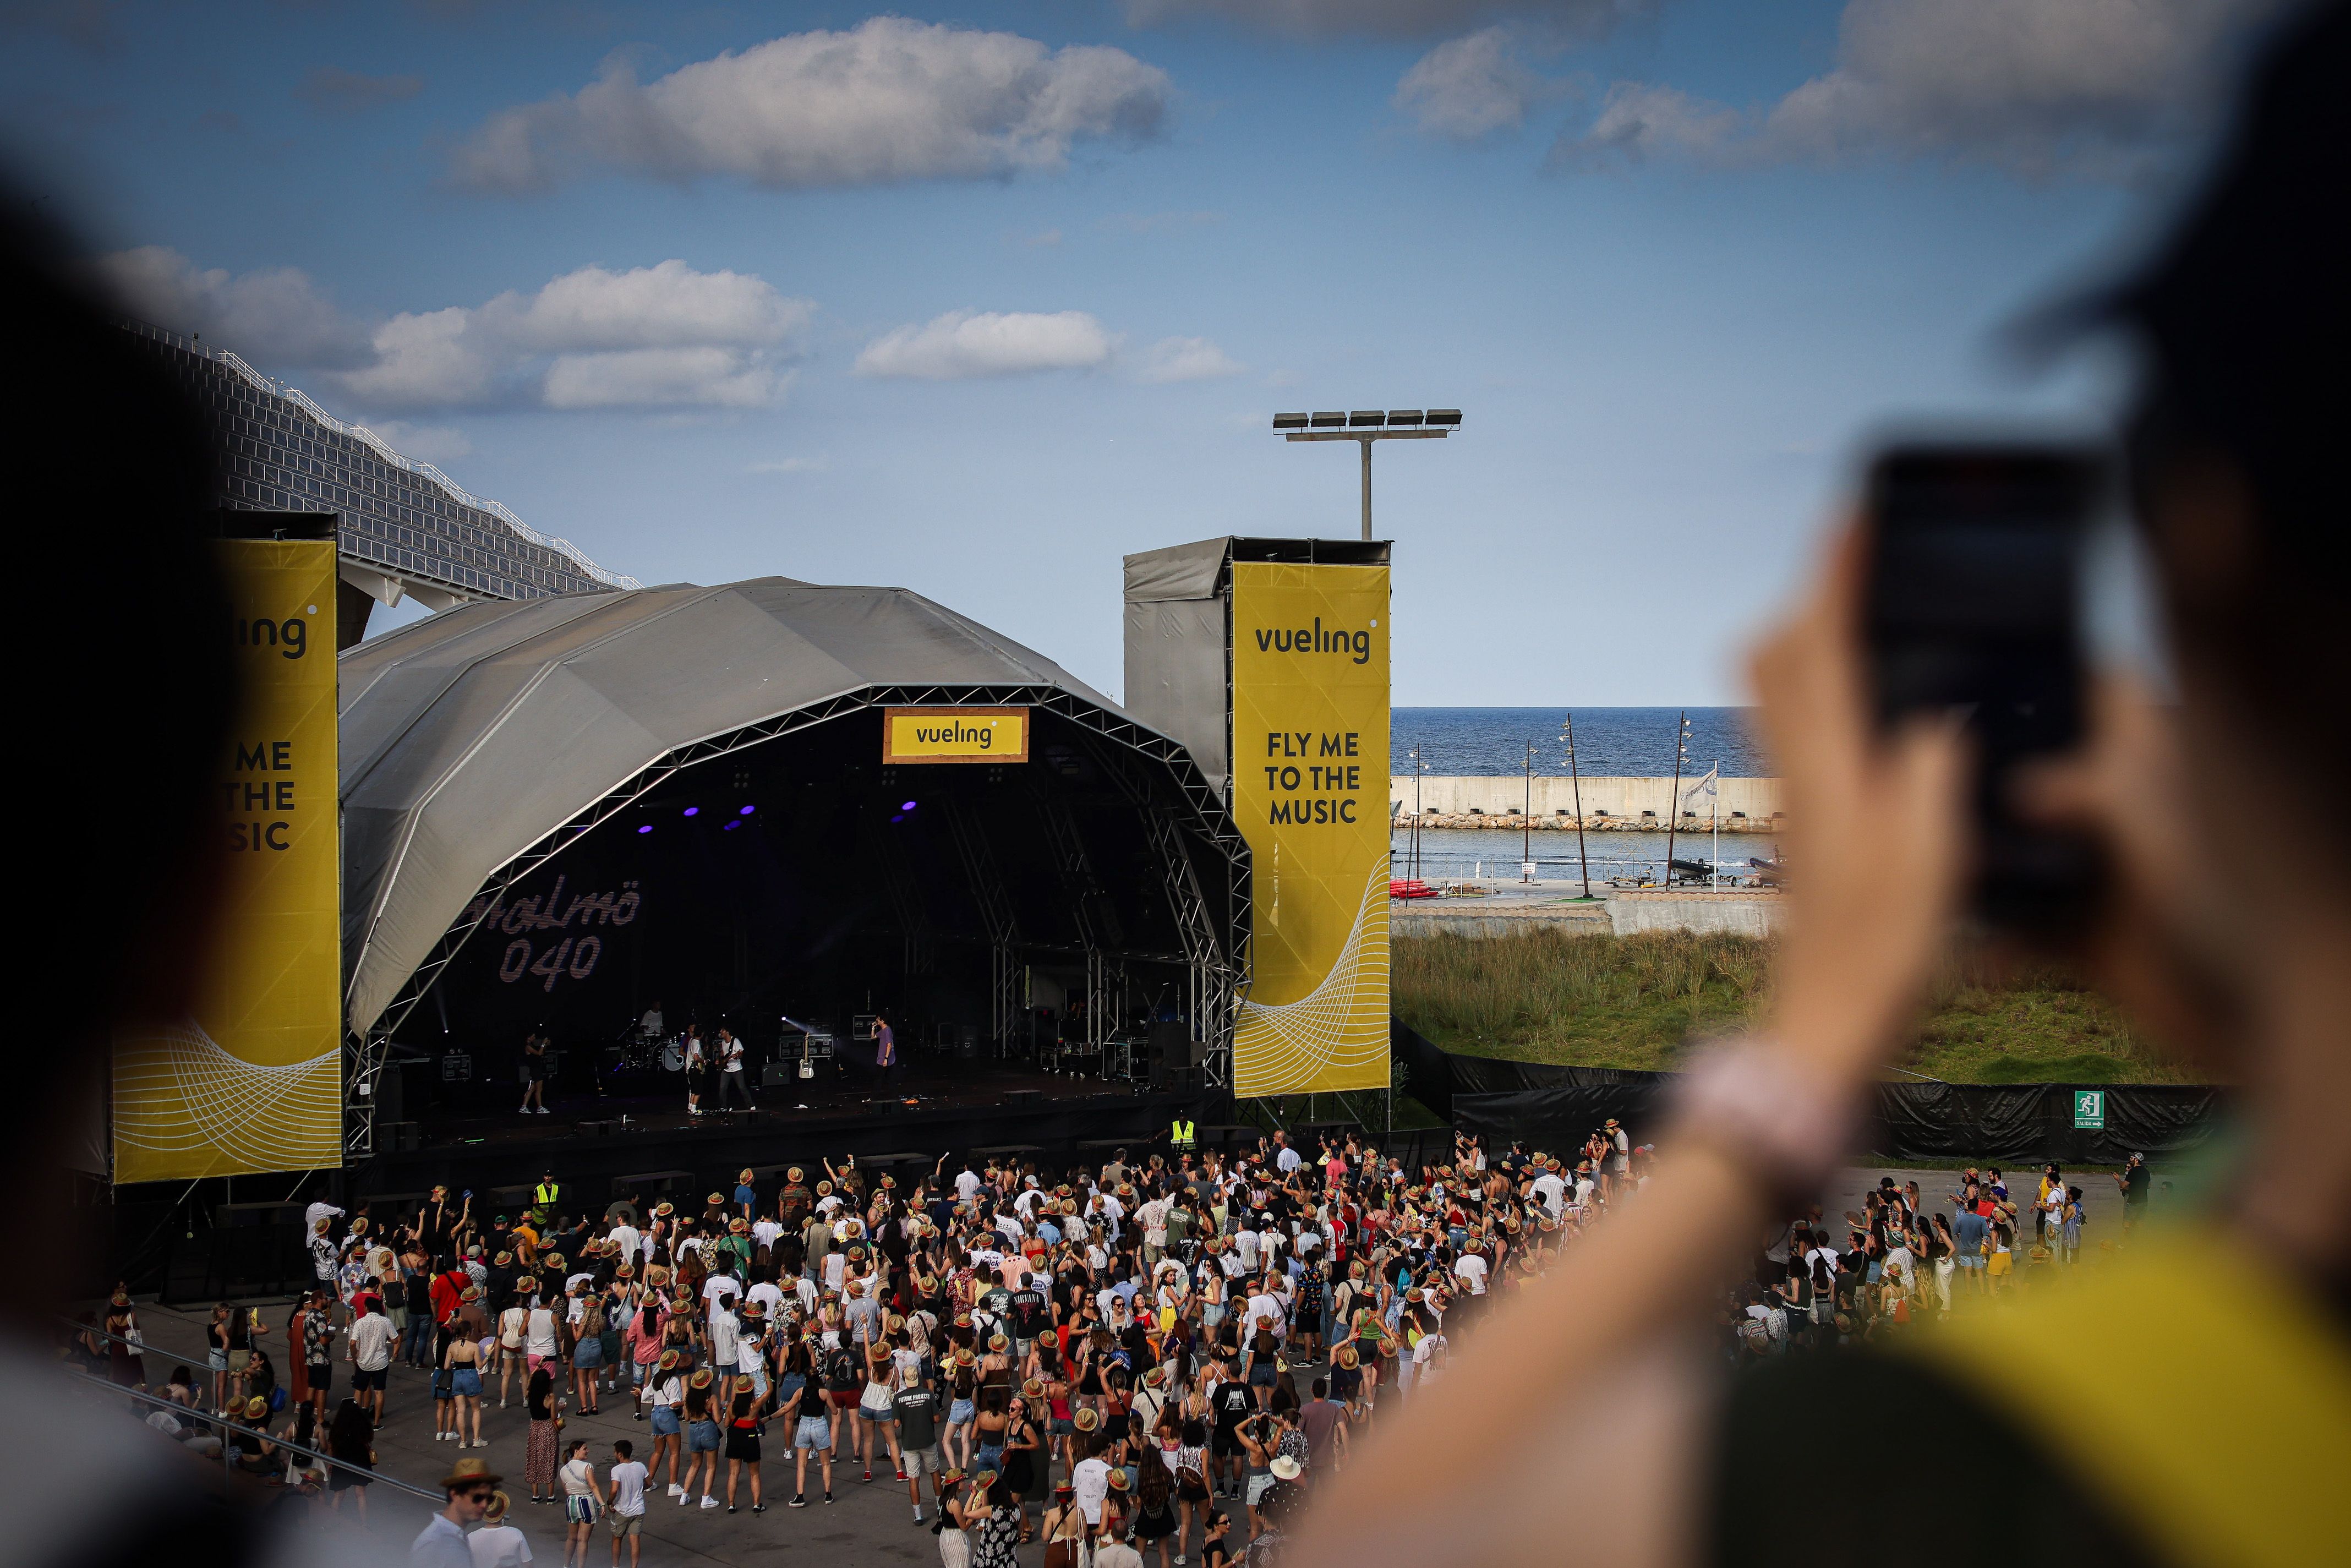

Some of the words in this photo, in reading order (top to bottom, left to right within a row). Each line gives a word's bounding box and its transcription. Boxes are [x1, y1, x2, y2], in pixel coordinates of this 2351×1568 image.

[238, 618, 307, 659] ing
[1255, 616, 1370, 665] vueling
[916, 720, 992, 749] vueling
[1267, 732, 1313, 758] FLY
[1319, 732, 1359, 757] ME
[235, 741, 292, 771] ME
[1264, 766, 1302, 791] TO
[1309, 766, 1360, 791] THE
[221, 782, 296, 812] THE
[1269, 799, 1357, 825] MUSIC
[228, 821, 291, 851] SIC
[499, 935, 602, 992] 040
[1338, 1229, 1345, 1245] 14
[1014, 1293, 1039, 1305] NIRVANA
[898, 1395, 912, 1403] FUTURE
[912, 1393, 930, 1401] PROJECTS
